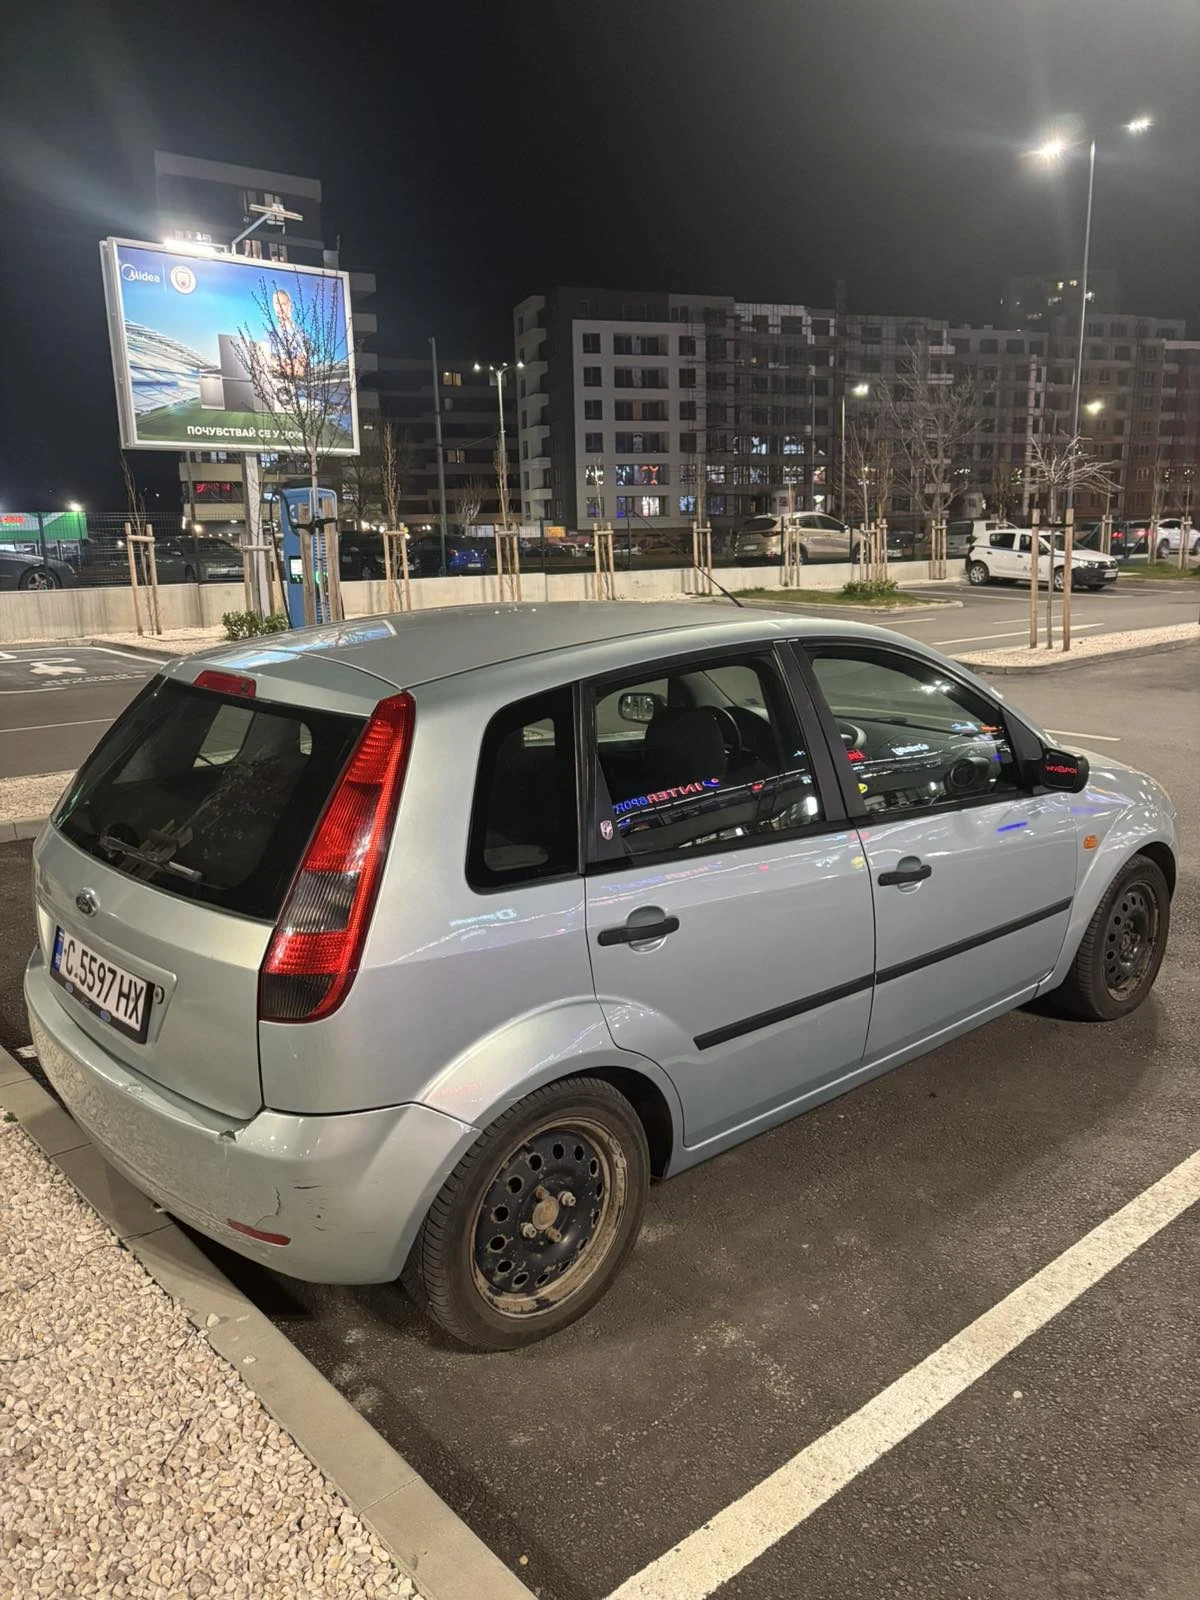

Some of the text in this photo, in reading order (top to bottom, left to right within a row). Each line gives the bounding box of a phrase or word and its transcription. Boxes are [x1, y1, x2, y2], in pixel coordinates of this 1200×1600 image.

[121, 263, 160, 283] Midea
[187, 426, 256, 438] ПОЧУВСТВАЙ
[258, 429, 271, 438] СЕ
[272, 430, 280, 439] У
